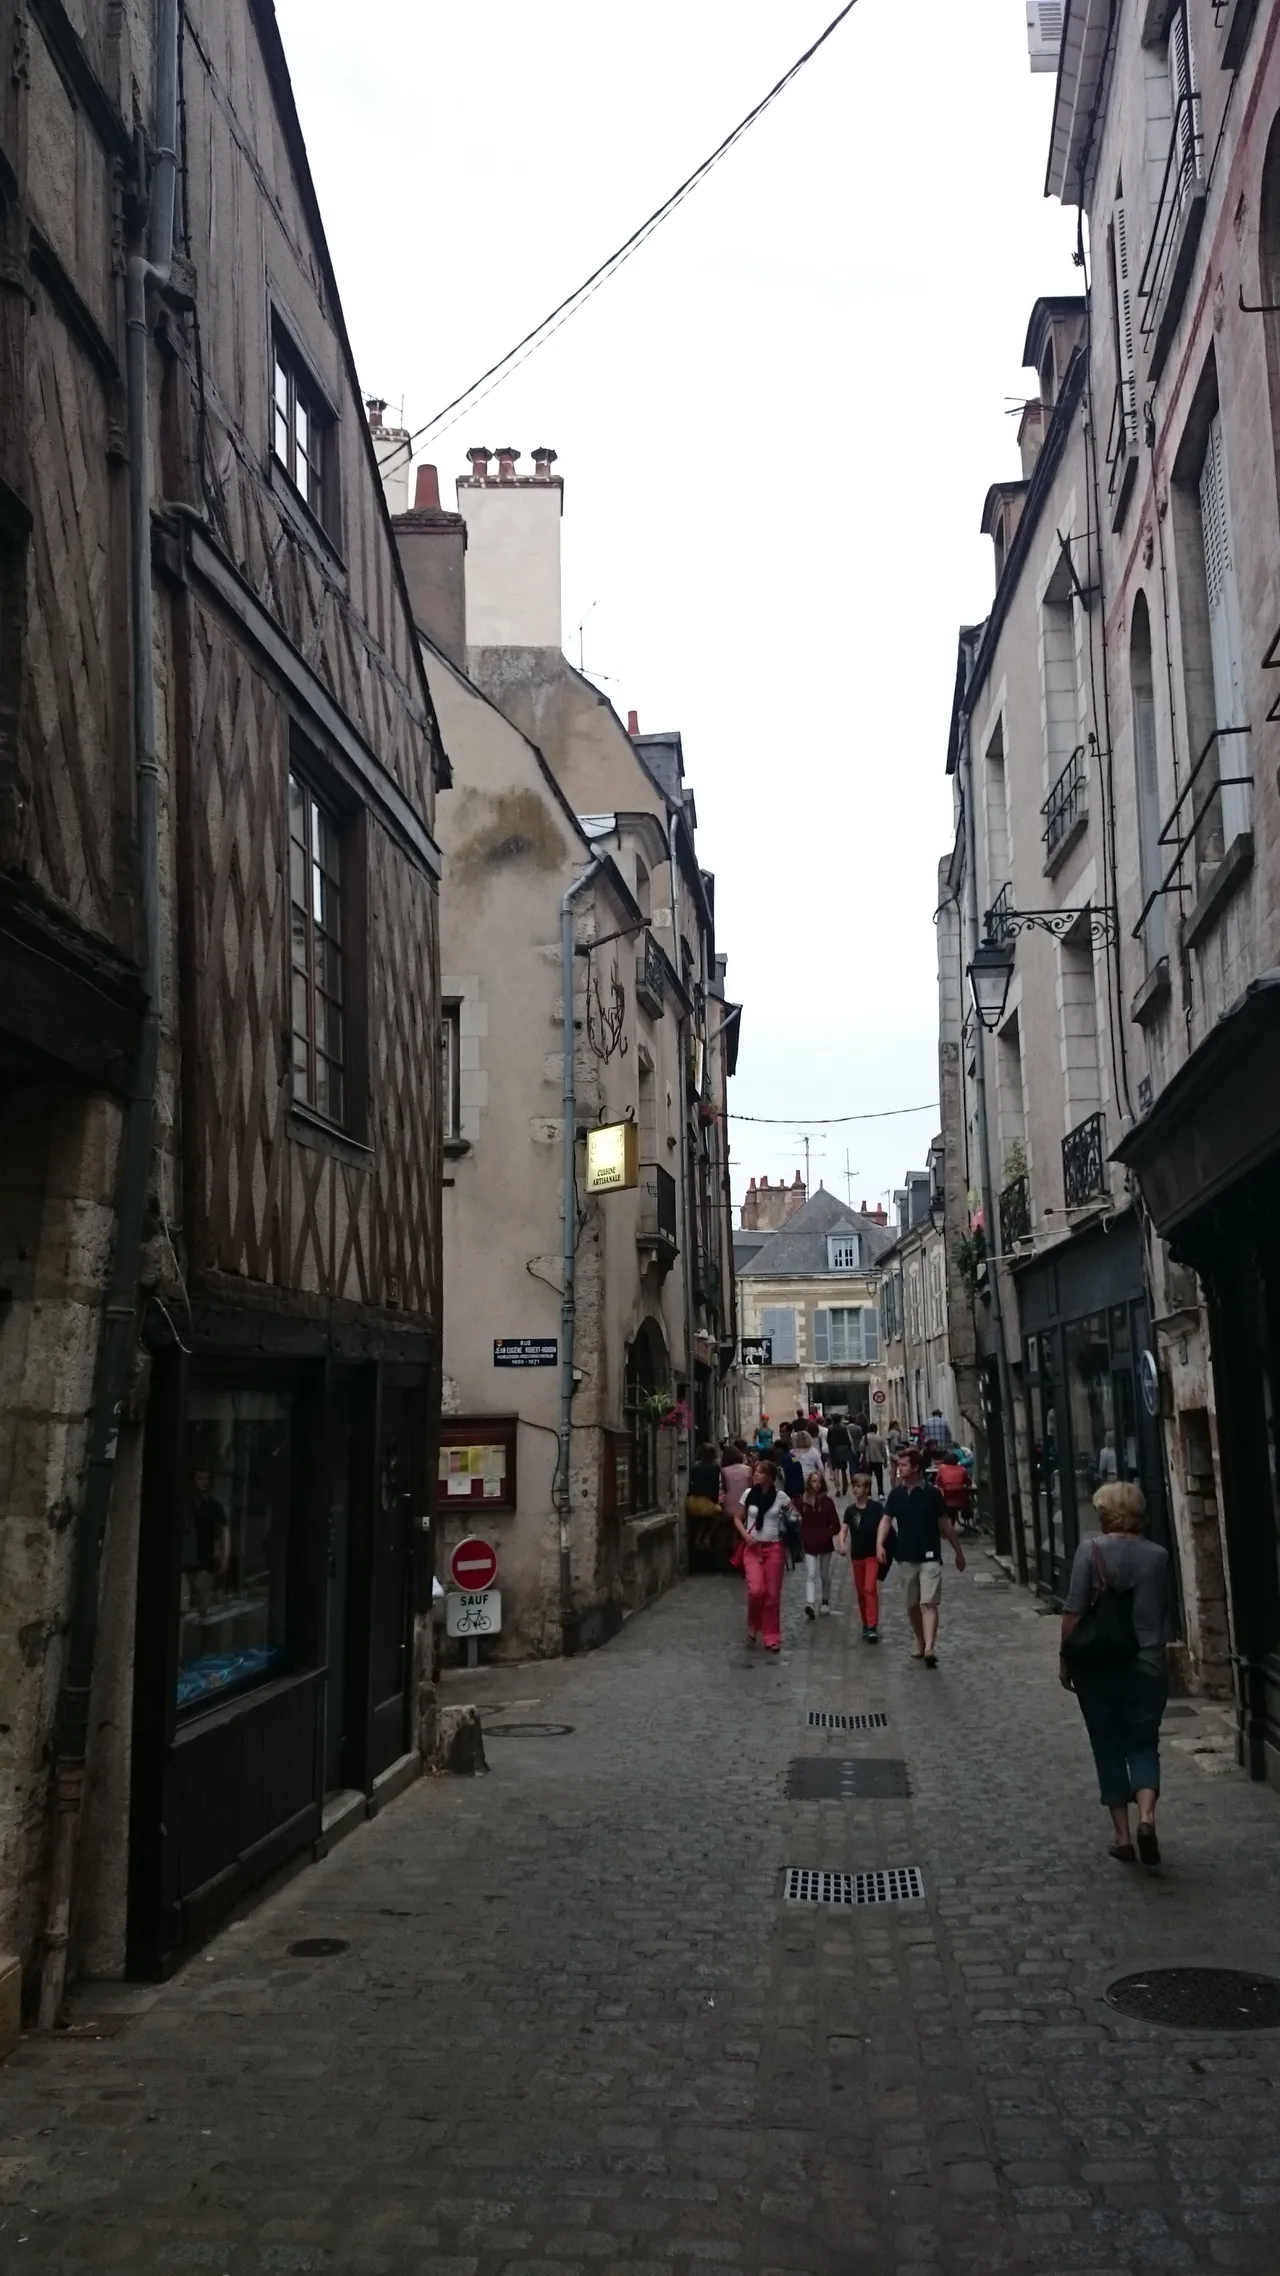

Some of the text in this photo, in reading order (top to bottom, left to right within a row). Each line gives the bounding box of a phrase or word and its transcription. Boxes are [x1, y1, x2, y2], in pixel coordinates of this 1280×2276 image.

[597, 1166, 616, 1176] CUISINE
[593, 1174, 620, 1185] ARTISANALE
[460, 1595, 488, 1606] SAUF
